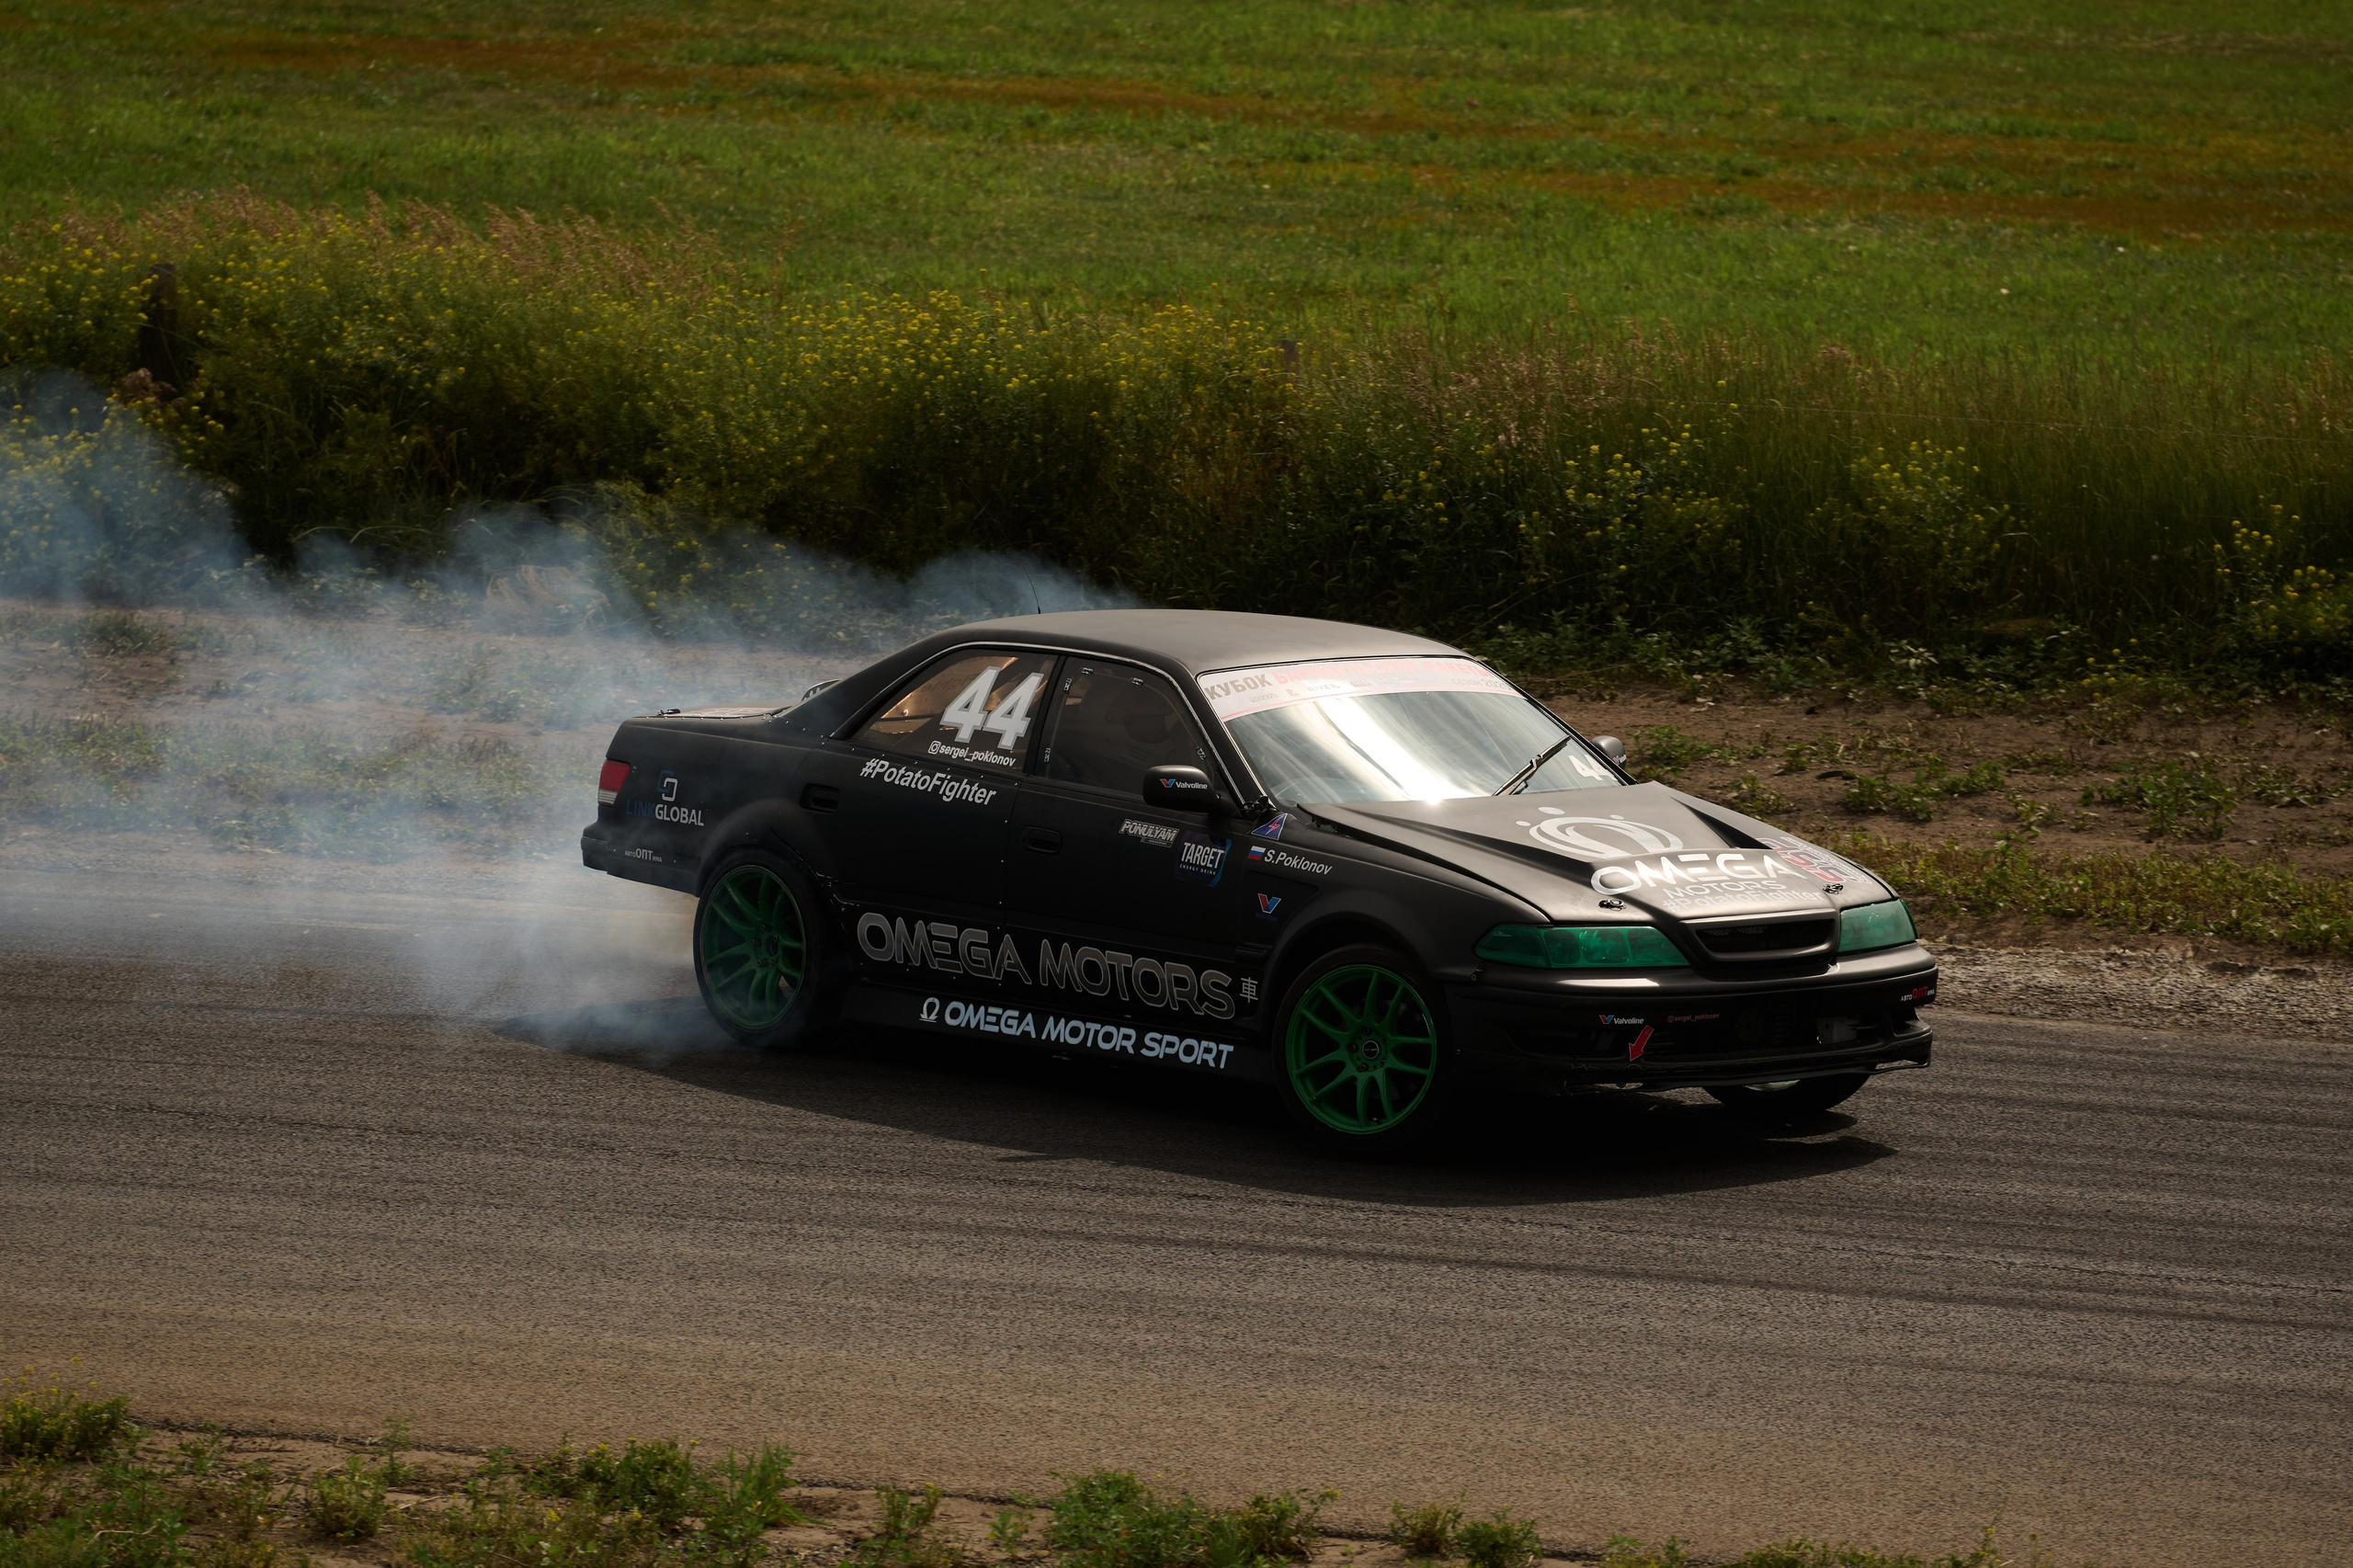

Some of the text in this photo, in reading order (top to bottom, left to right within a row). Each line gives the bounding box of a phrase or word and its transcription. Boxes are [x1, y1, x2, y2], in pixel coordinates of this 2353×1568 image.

[1204, 674, 1274, 700] КУБОК
[938, 665, 1045, 751] 44
[859, 757, 997, 805] #PotatoFighter
[1568, 755, 1619, 781] 44
[1175, 780, 1209, 790] Valvoline
[1120, 820, 1178, 842] PONULYAM
[1179, 863, 1199, 872] ENERGY
[1181, 842, 1224, 869] TARGET
[1264, 849, 1334, 875] S.Poklonov
[1590, 852, 1807, 895] OMEGA
[1661, 889, 1824, 913] #PotatoFighter
[1662, 879, 1786, 899] MOTORS
[857, 912, 1236, 1020] OMEGA MOTORS
[1240, 976, 1259, 1004] 車
[1613, 1016, 1644, 1026] Valvoline
[944, 1000, 1234, 1070] OMEGA MOTOR SPORT
